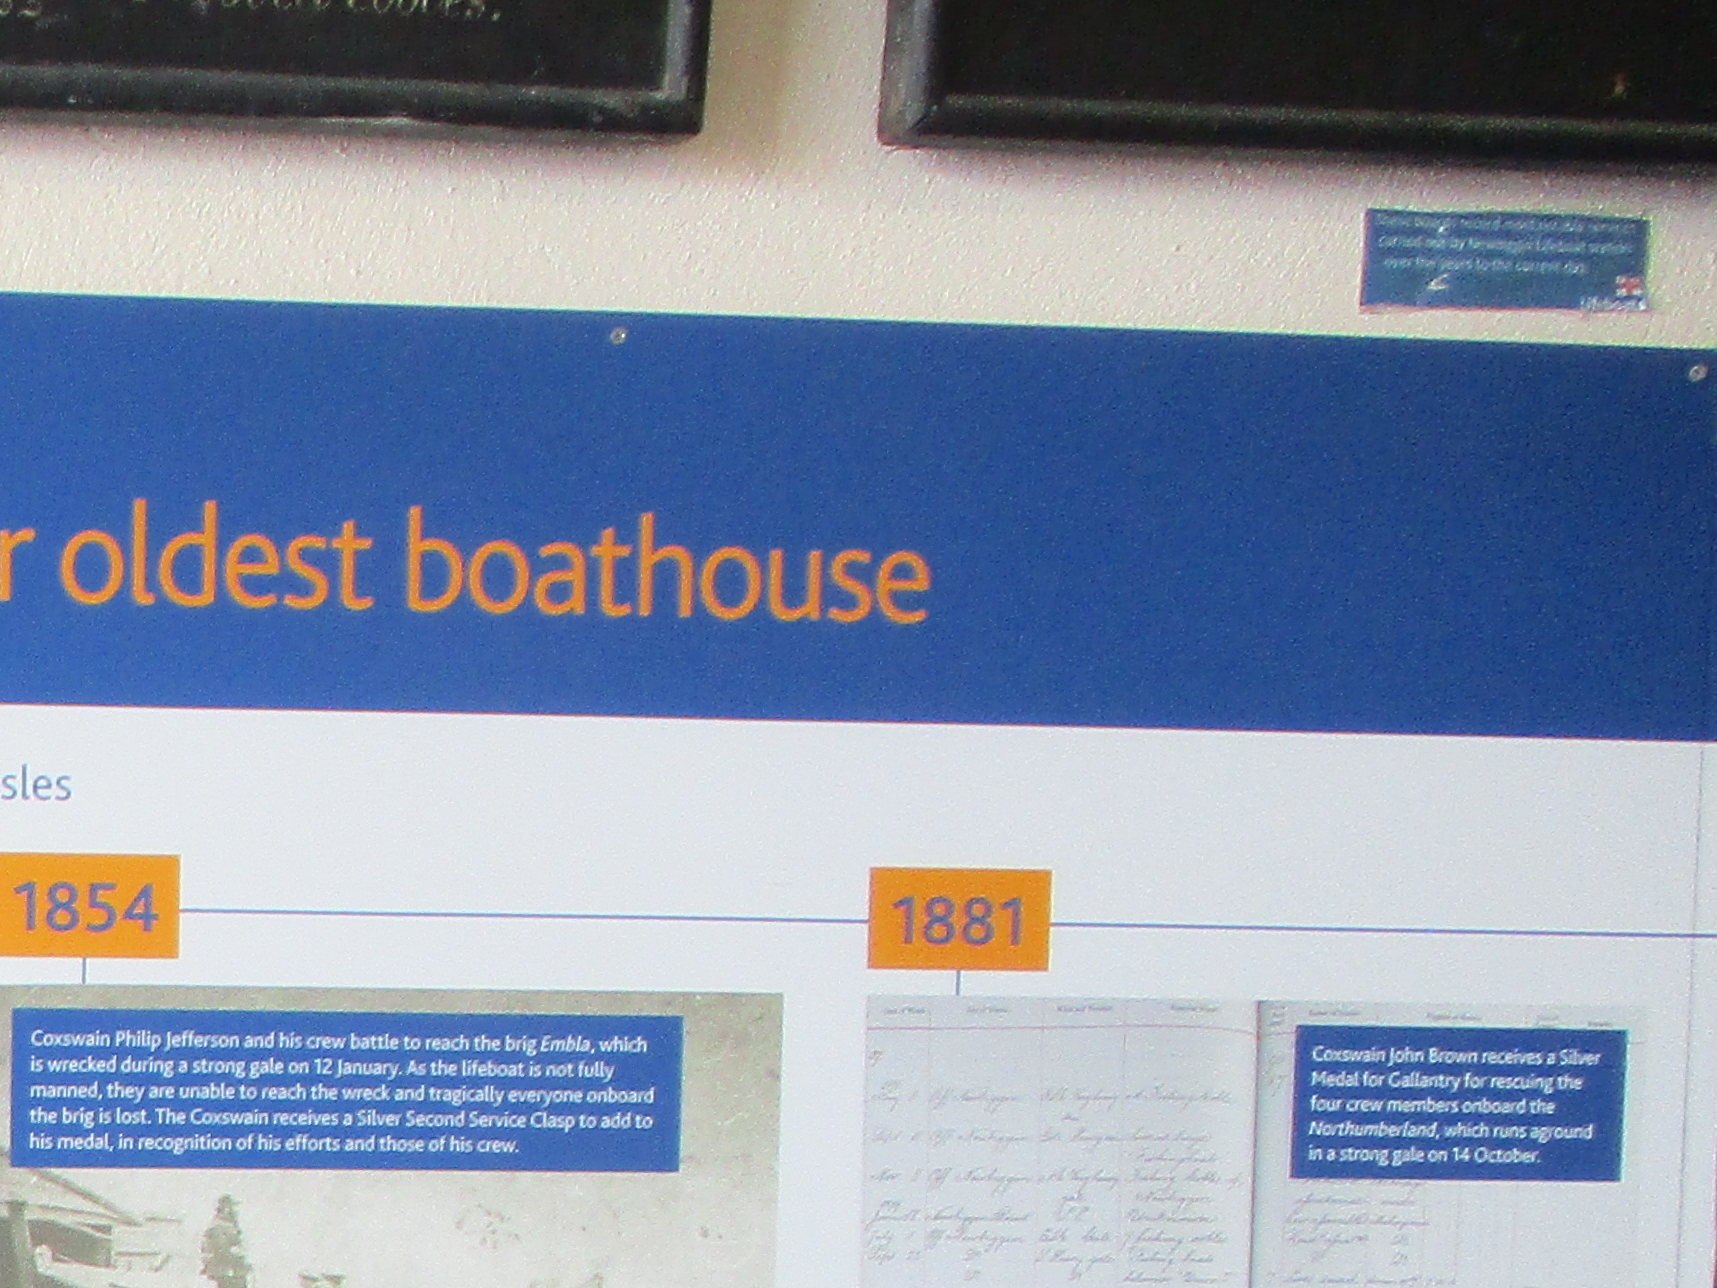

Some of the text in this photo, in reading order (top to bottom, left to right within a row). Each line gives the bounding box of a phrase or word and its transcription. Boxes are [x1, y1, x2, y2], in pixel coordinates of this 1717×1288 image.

[60, 497, 374, 610] oldest
[407, 505, 930, 624] boathouse
[15, 882, 158, 932] 1854
[895, 896, 1022, 945] 1881
[30, 1029, 647, 1056] Coxswain Philip Jefferson and his crew battle to reach the brig Embla, which
[1311, 1044, 1386, 1062] Coxswain
[1387, 1046, 1425, 1066] John
[1428, 1046, 1478, 1064] Brown
[1481, 1048, 1544, 1065] receives
[1558, 1048, 1601, 1065] Silver
[30, 1054, 614, 1082] is wrecked during a strong gale on 12 January. As the lifeboat is not fully
[1308, 1120, 1594, 1143] Northumberland, which runs aground
[1339, 1147, 1389, 1166] strong
[1391, 1145, 1425, 1166] gale
[1473, 1146, 1540, 1163] October.
